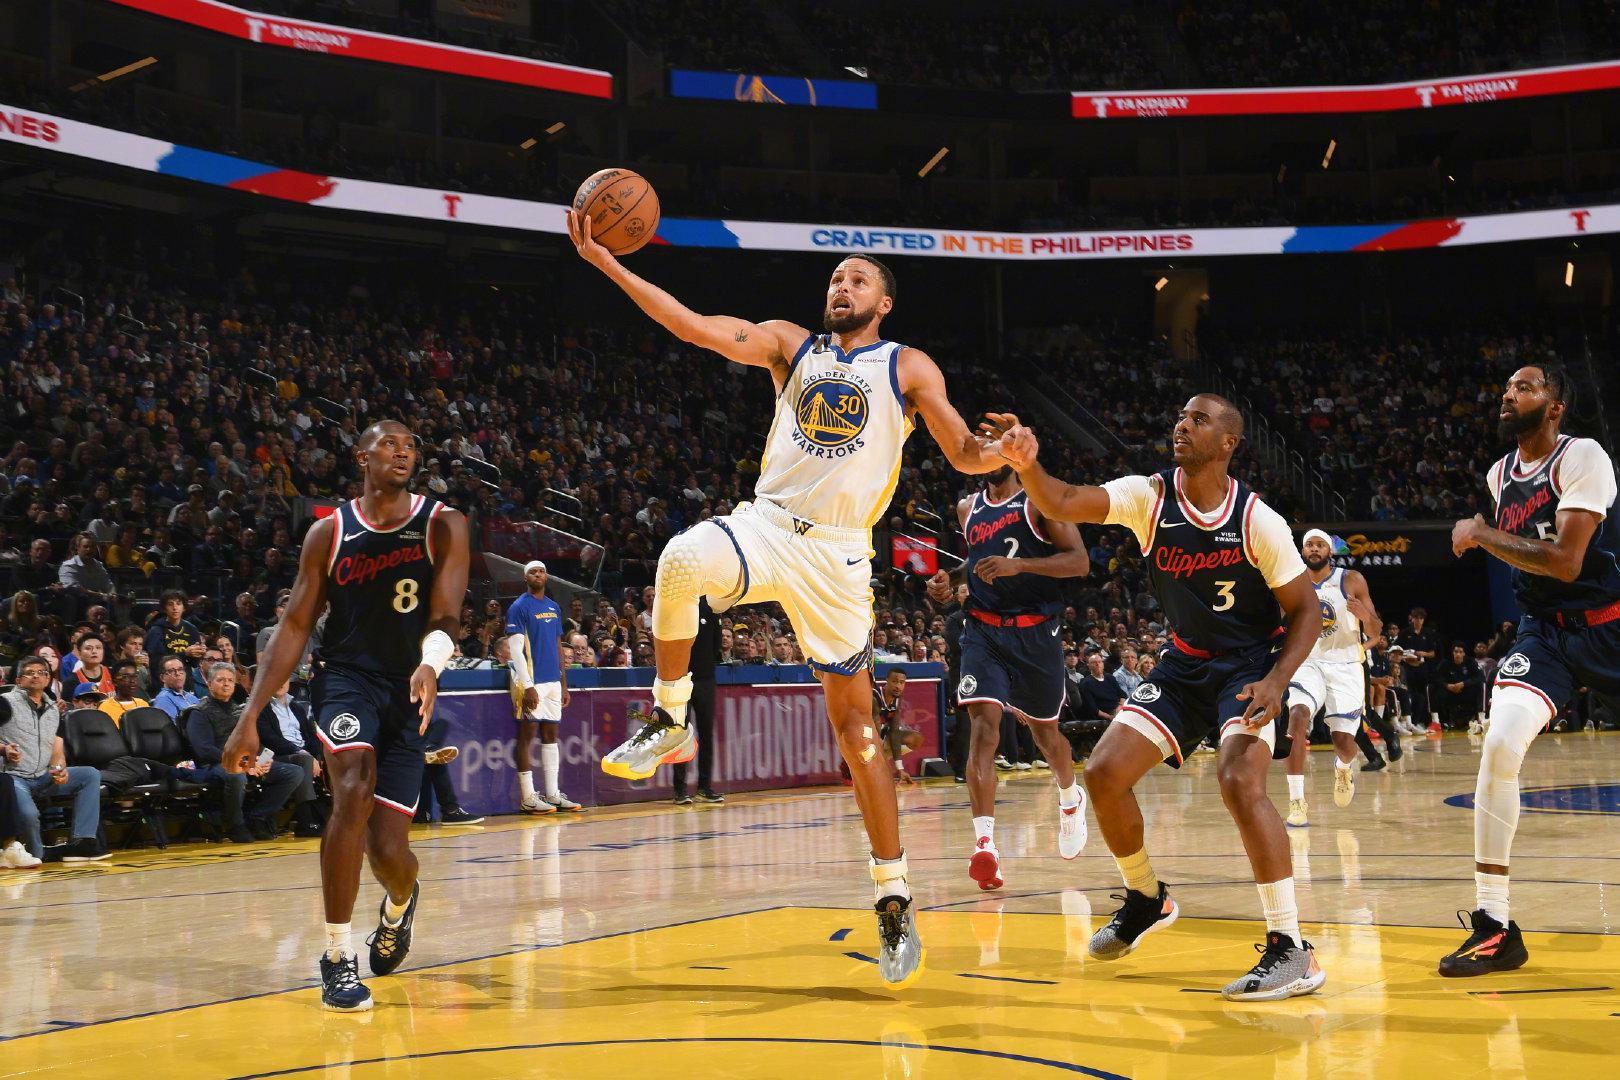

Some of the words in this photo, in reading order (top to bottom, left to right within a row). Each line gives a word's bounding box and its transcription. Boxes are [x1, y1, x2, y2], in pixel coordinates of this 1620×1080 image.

[1114, 96, 1188, 110] TANDUAY
[1441, 79, 1518, 97] TANDUAY
[811, 230, 935, 250] CRAFTED
[943, 235, 968, 252] IN
[972, 236, 1024, 254] THE
[1031, 234, 1193, 254] PHILIPPINES
[802, 371, 846, 386] GOLDEN
[849, 374, 873, 395] STATE
[835, 395, 860, 415] 30
[791, 427, 865, 459] WARRIORS
[1498, 485, 1551, 536] Clippers
[969, 511, 1020, 546] Clippers
[1004, 537, 1020, 559] 2
[1156, 546, 1243, 579] Clippers
[1361, 555, 1402, 566] AREA
[335, 543, 424, 586] Clippers
[393, 578, 419, 614] 8
[1212, 581, 1235, 612] 3
[724, 694, 842, 783] MONDA
